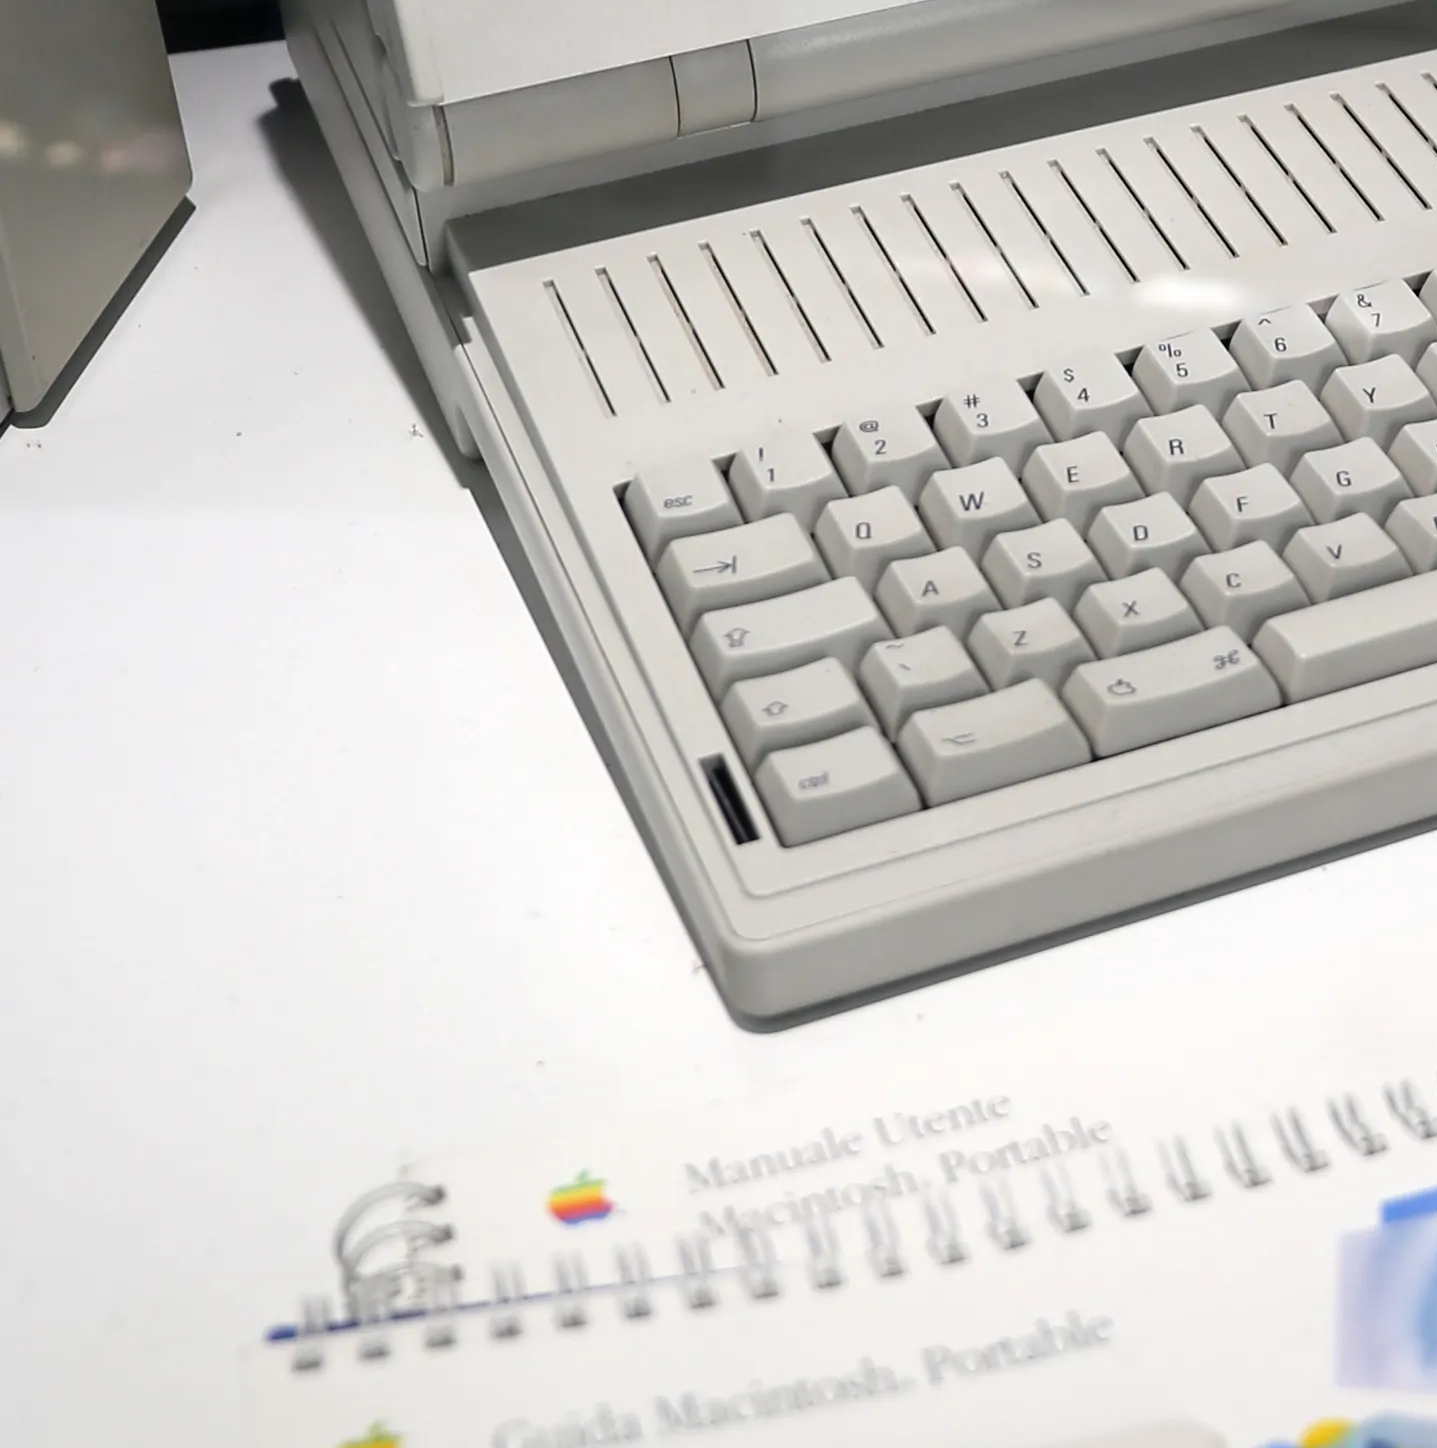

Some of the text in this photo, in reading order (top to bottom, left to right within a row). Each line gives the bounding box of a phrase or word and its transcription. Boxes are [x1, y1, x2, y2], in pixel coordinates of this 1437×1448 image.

[1356, 293, 1372, 308] &
[1371, 312, 1381, 328] 7
[1158, 343, 1182, 358] %
[1274, 337, 1287, 352] 6
[1063, 368, 1075, 383] $
[1176, 363, 1189, 378] 5
[964, 394, 979, 409] #
[1077, 387, 1090, 402] 4
[1362, 387, 1376, 404] Y
[858, 420, 879, 433] @
[976, 413, 989, 428] 3
[1263, 413, 1277, 430] T
[758, 447, 764, 462] !
[874, 439, 887, 456] 2
[1168, 438, 1185, 456] R
[1066, 465, 1079, 484] E
[1335, 470, 1352, 487] G
[662, 493, 693, 510] esc
[959, 491, 984, 512] W
[1236, 495, 1250, 513] F
[855, 522, 872, 540] Q
[1133, 525, 1149, 542] D
[1027, 552, 1043, 570] S
[1327, 545, 1342, 560] V
[921, 580, 940, 597] A
[1225, 573, 1241, 588] C
[1123, 601, 1139, 618] X
[1013, 630, 1027, 648] Z
[684, 1093, 1011, 1194] Manuale Utente
[938, 1116, 1114, 1184] Portable
[921, 1309, 1115, 1386] Portable
